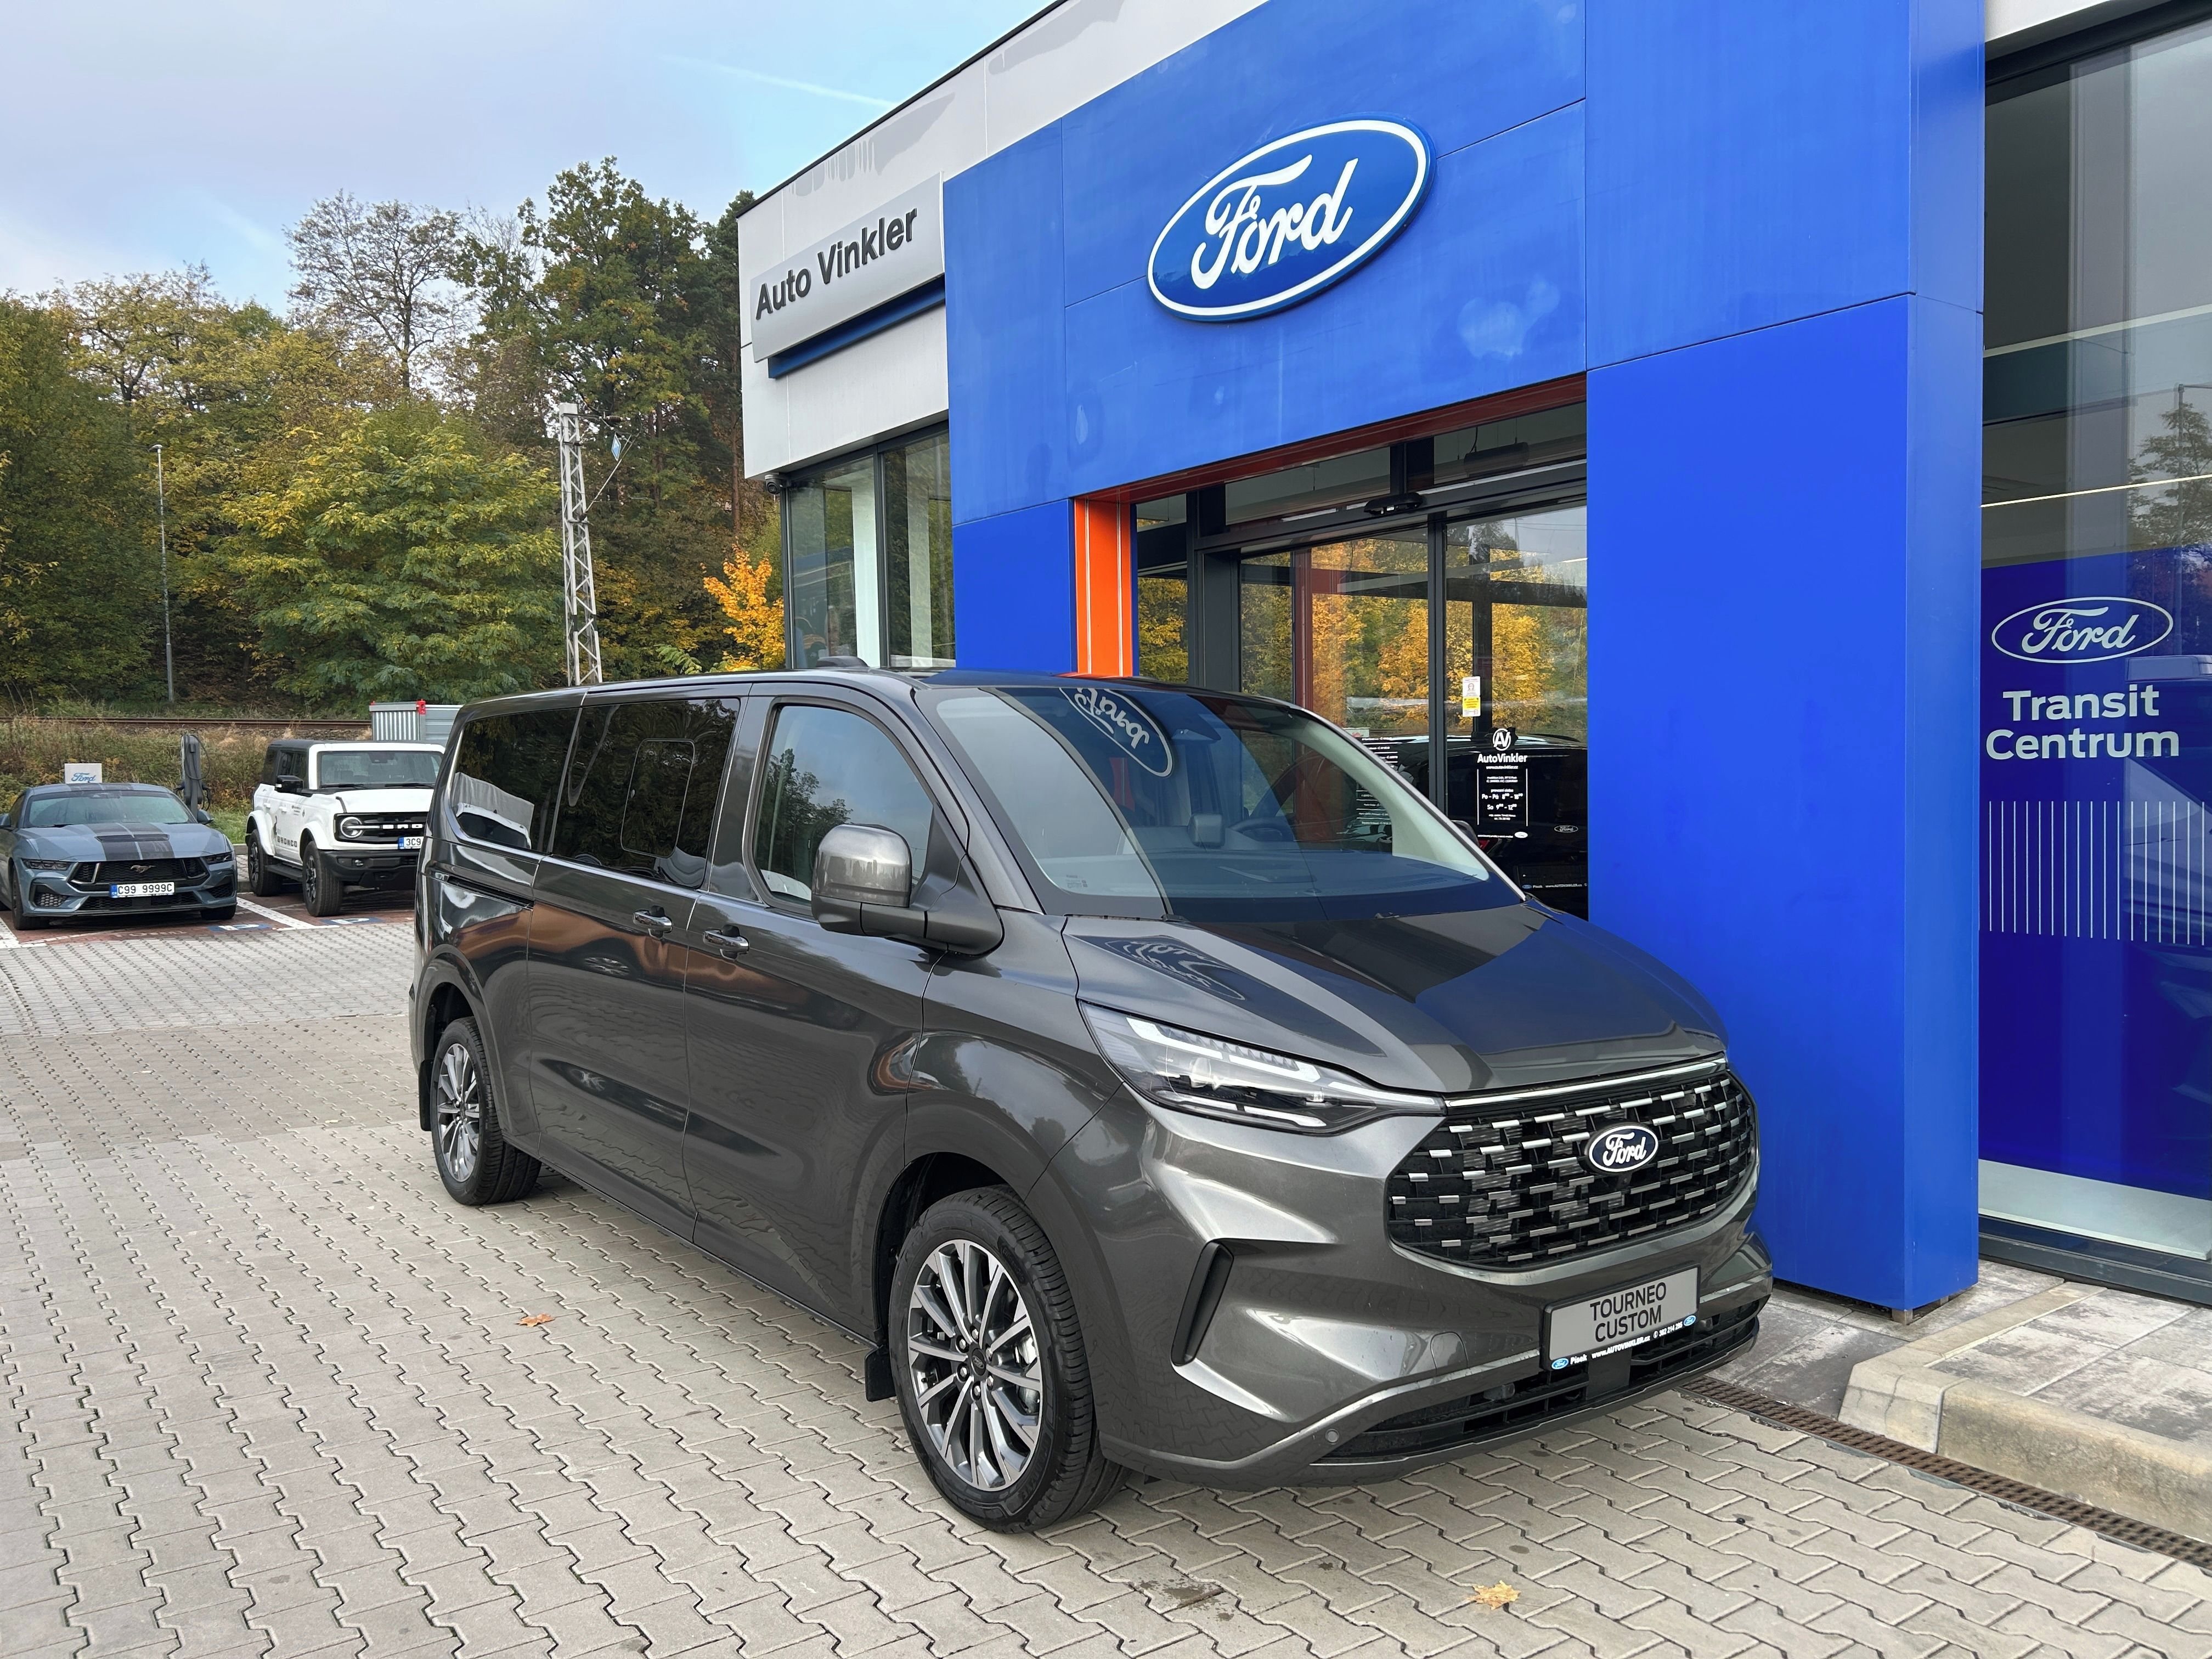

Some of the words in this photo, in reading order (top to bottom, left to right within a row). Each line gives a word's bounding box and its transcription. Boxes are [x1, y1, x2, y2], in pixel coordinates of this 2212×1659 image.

[1191, 154, 1358, 289] Ford
[755, 268, 811, 320] Auto
[817, 208, 917, 285] Vinkler
[2022, 606, 2140, 653] Ford
[2002, 684, 2159, 721] Transit
[1477, 753, 1528, 763] AutoVinkler
[1986, 727, 2180, 760] Centrum
[71, 772, 97, 781] Ford
[277, 836, 297, 848] BRONCO
[118, 885, 136, 894] C99
[142, 884, 172, 893] 9999C
[1602, 1131, 1647, 1166] Ford
[1590, 1282, 1667, 1321] TOURNEO
[1595, 1305, 1661, 1342] CUSTOM
